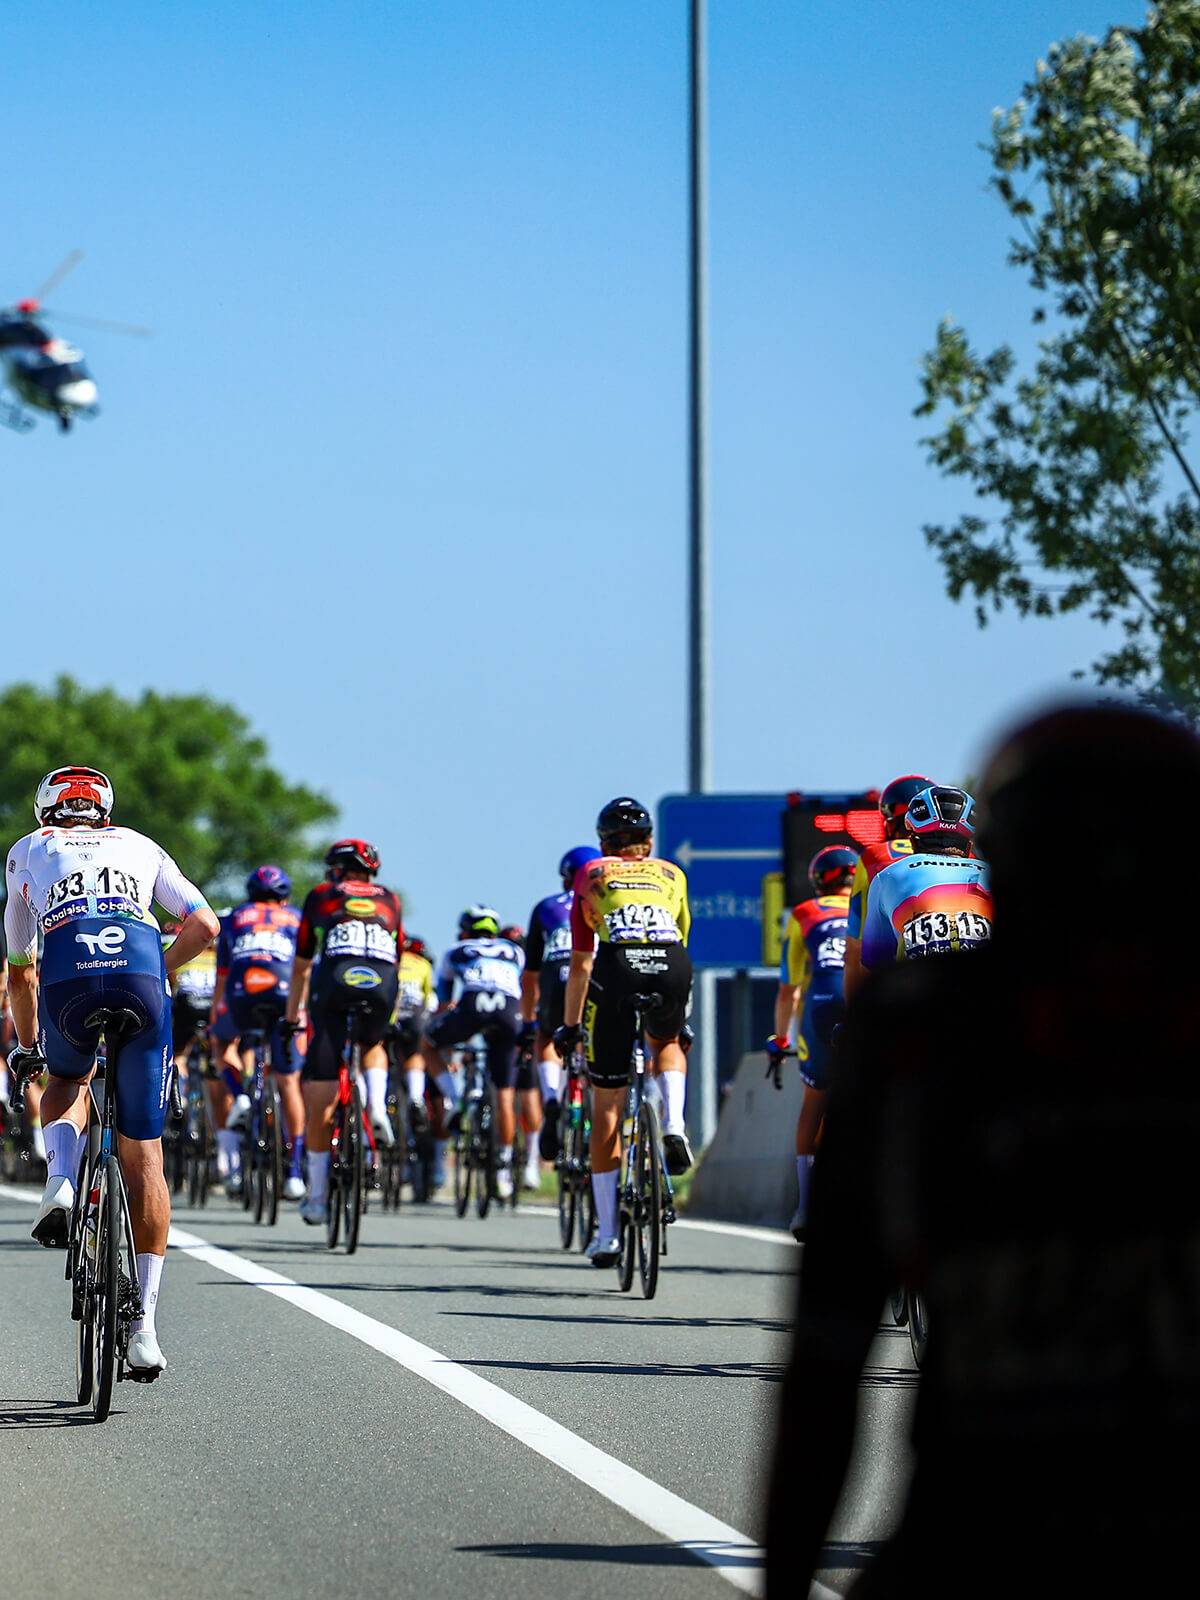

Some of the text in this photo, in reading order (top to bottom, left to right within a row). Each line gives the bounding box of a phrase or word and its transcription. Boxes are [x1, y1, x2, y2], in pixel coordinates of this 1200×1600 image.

[939, 822, 957, 830] KASK
[909, 860, 986, 871] UNIBET
[905, 913, 949, 945] 153
[958, 912, 990, 939] 15
[76, 958, 128, 970] TotalEnergies
